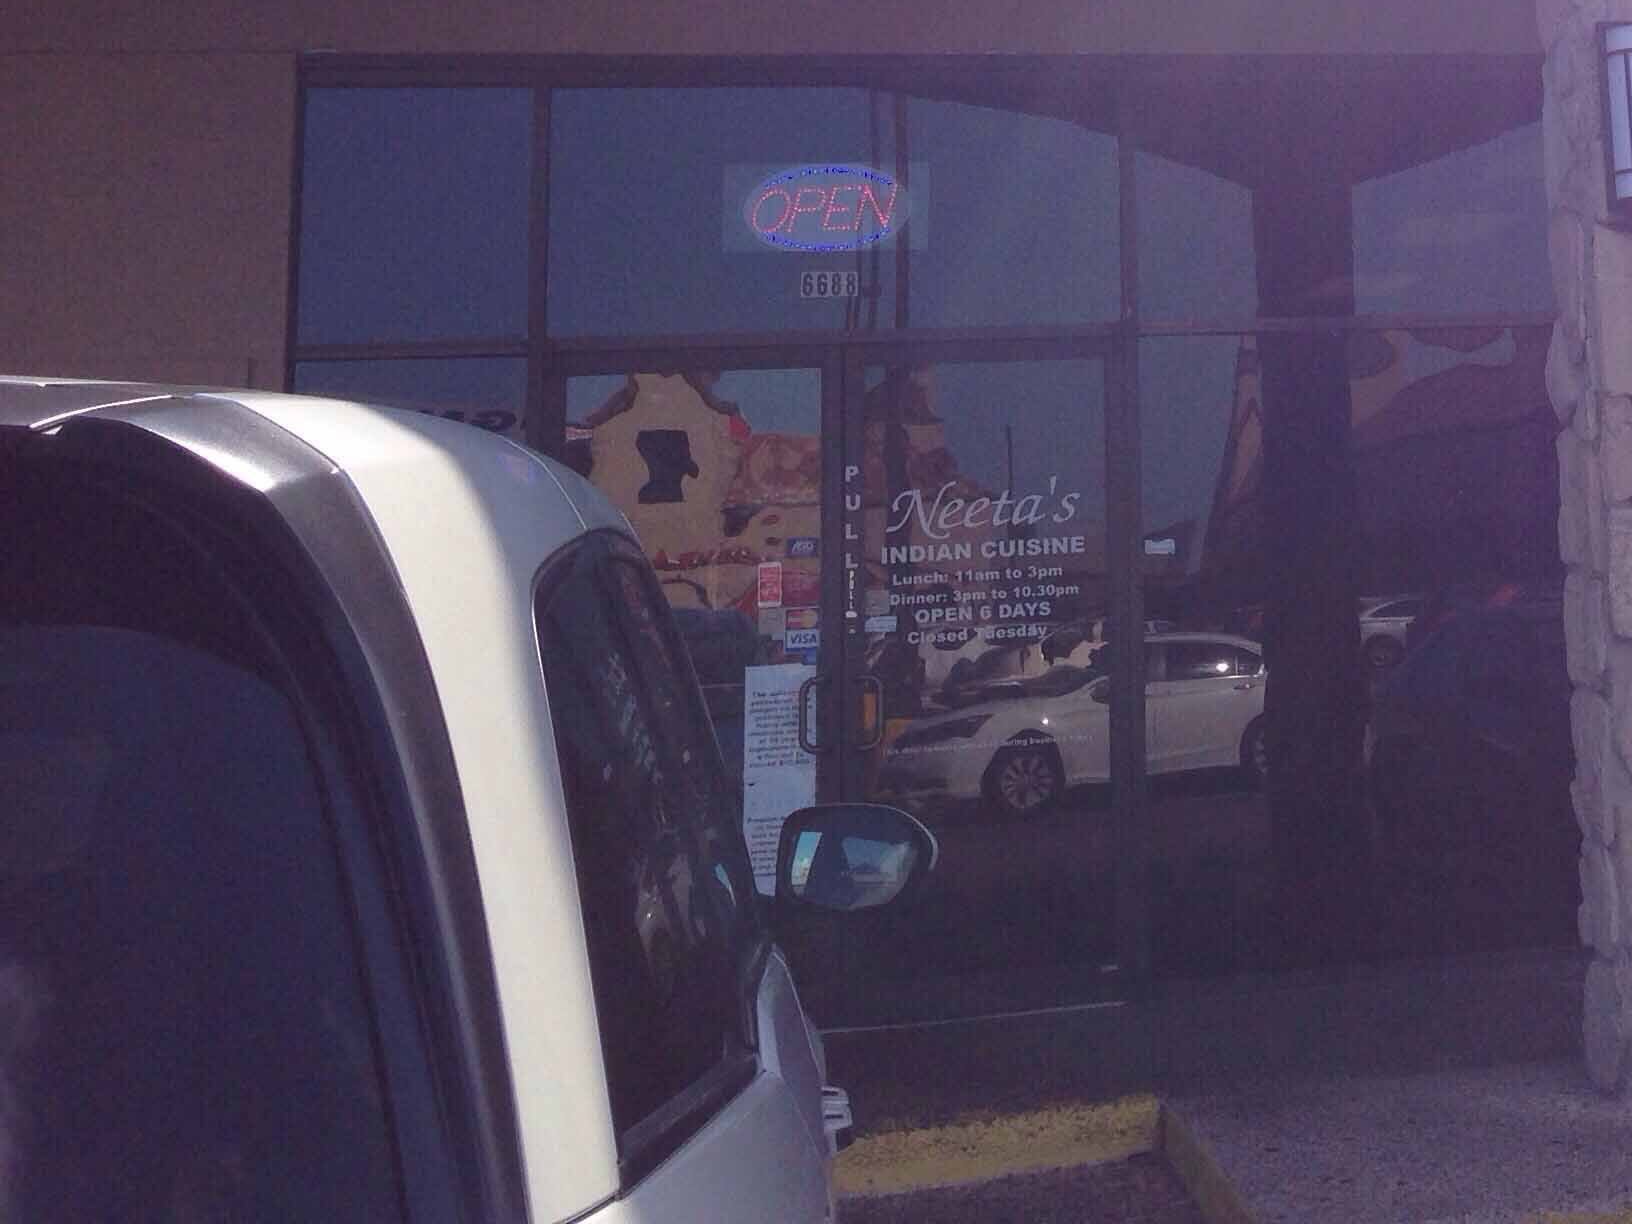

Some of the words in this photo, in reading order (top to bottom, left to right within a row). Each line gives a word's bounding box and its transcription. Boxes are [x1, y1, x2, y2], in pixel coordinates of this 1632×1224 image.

[752, 183, 898, 233] OPEN
[802, 273, 858, 297] 6688
[885, 475, 1081, 539] Neeta's
[881, 542, 972, 564] INDIAN
[981, 536, 1085, 559] CUISINE
[892, 572, 949, 586] Lunch:
[955, 569, 1001, 583] 11am
[1006, 566, 1022, 579] to
[1028, 566, 1063, 581] 3pm
[889, 590, 948, 607] Dinner:
[952, 589, 987, 605] 3pm
[991, 587, 1008, 600] to
[1013, 584, 1080, 601] 10.30pm
[915, 606, 973, 624] OPEN
[999, 601, 1051, 619] DAYS
[790, 633, 817, 647] VISA
[907, 626, 969, 645] Closed
[975, 624, 1048, 644] Tuesday
